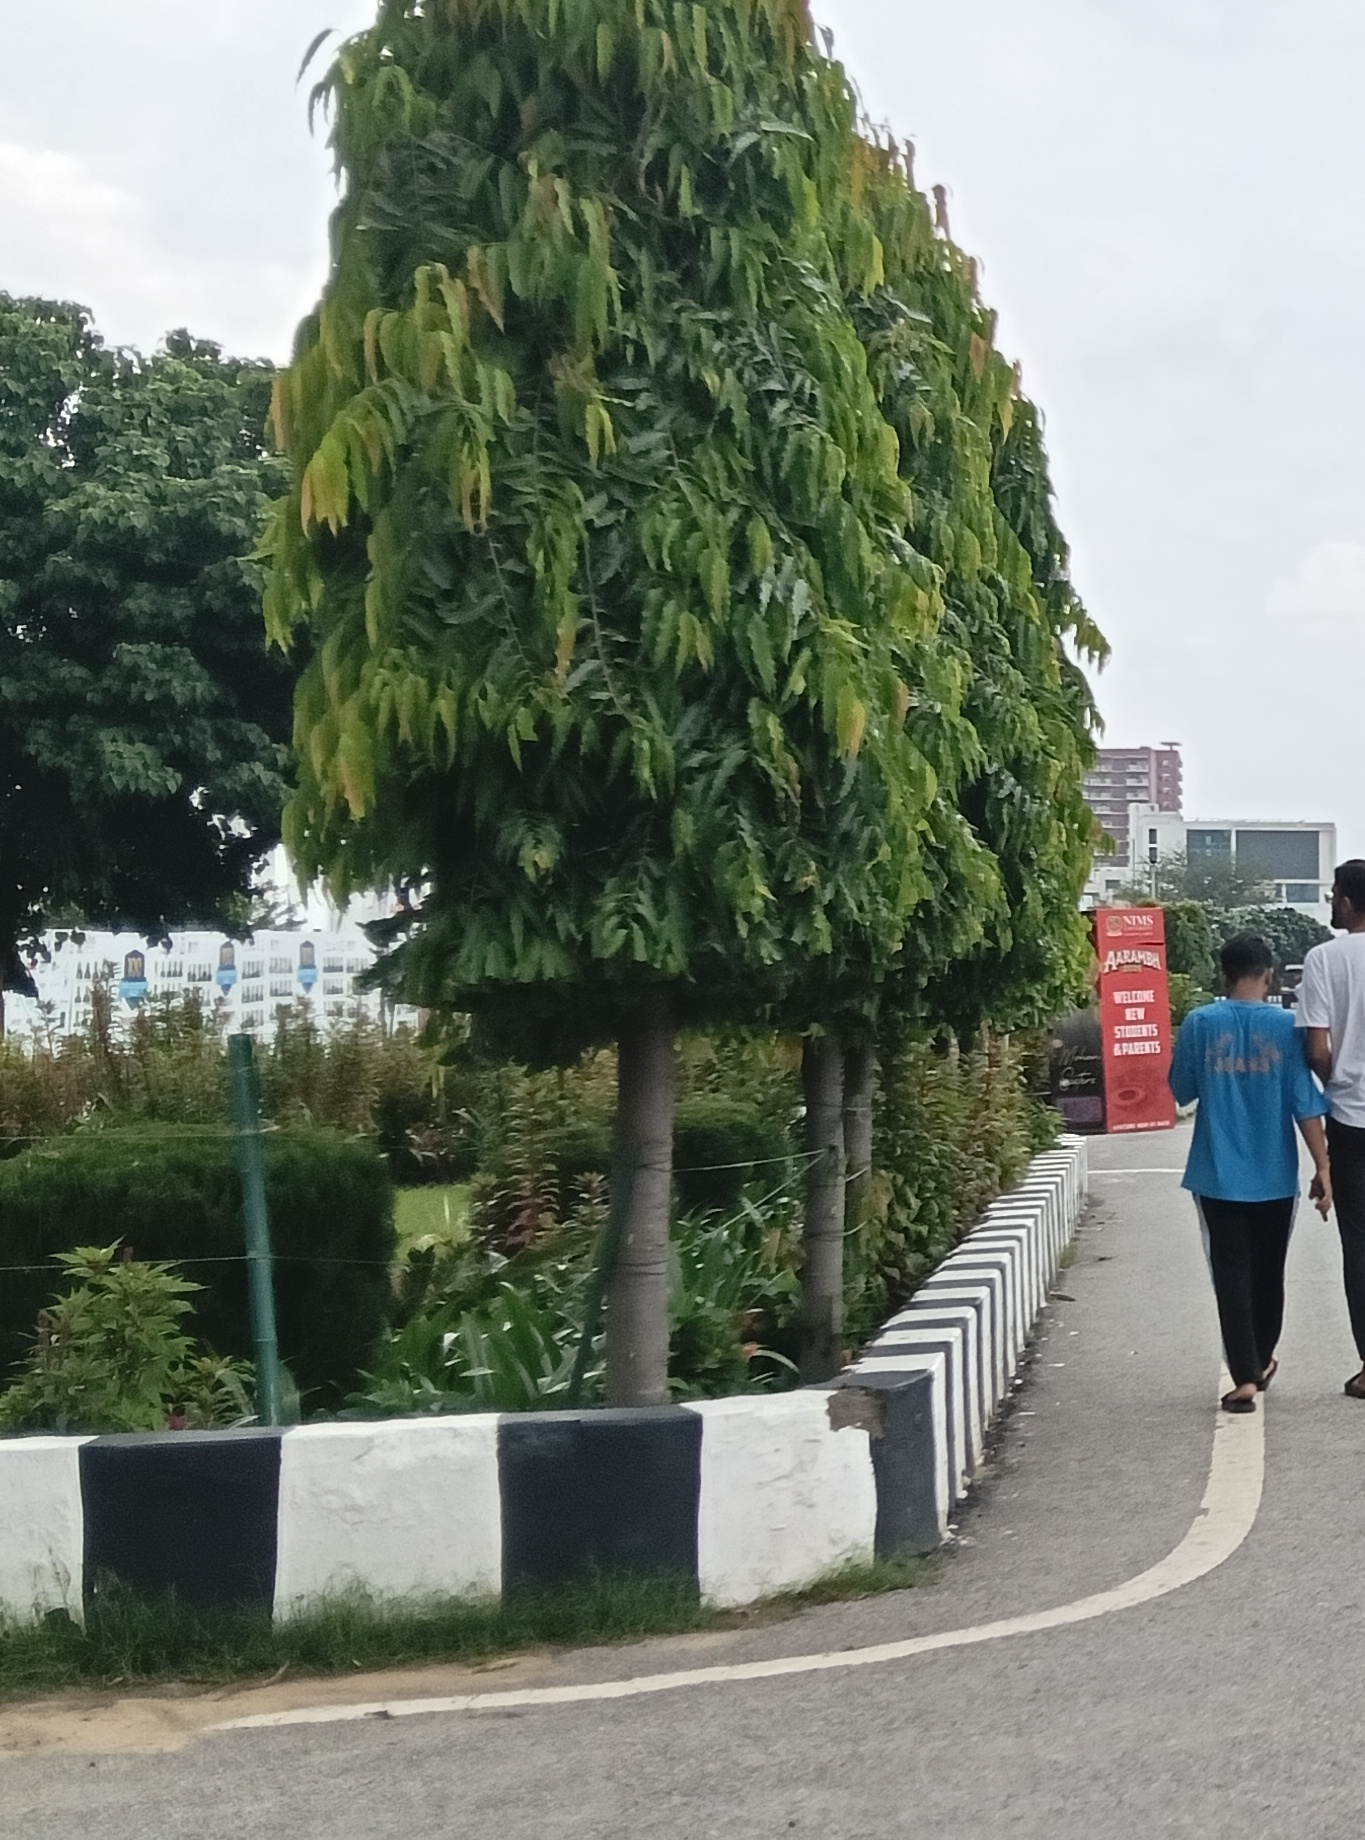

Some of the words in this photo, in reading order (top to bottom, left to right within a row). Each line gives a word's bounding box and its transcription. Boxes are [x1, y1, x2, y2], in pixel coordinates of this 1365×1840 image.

[1123, 915, 1154, 926] NIMS
[1103, 949, 1162, 975] AARAMBH
[1113, 990, 1155, 1004] WELCOME
[1125, 1008, 1145, 1021] NEW
[1114, 1024, 1158, 1039] STUDENTS
[1122, 1041, 1161, 1055] PARENTS
